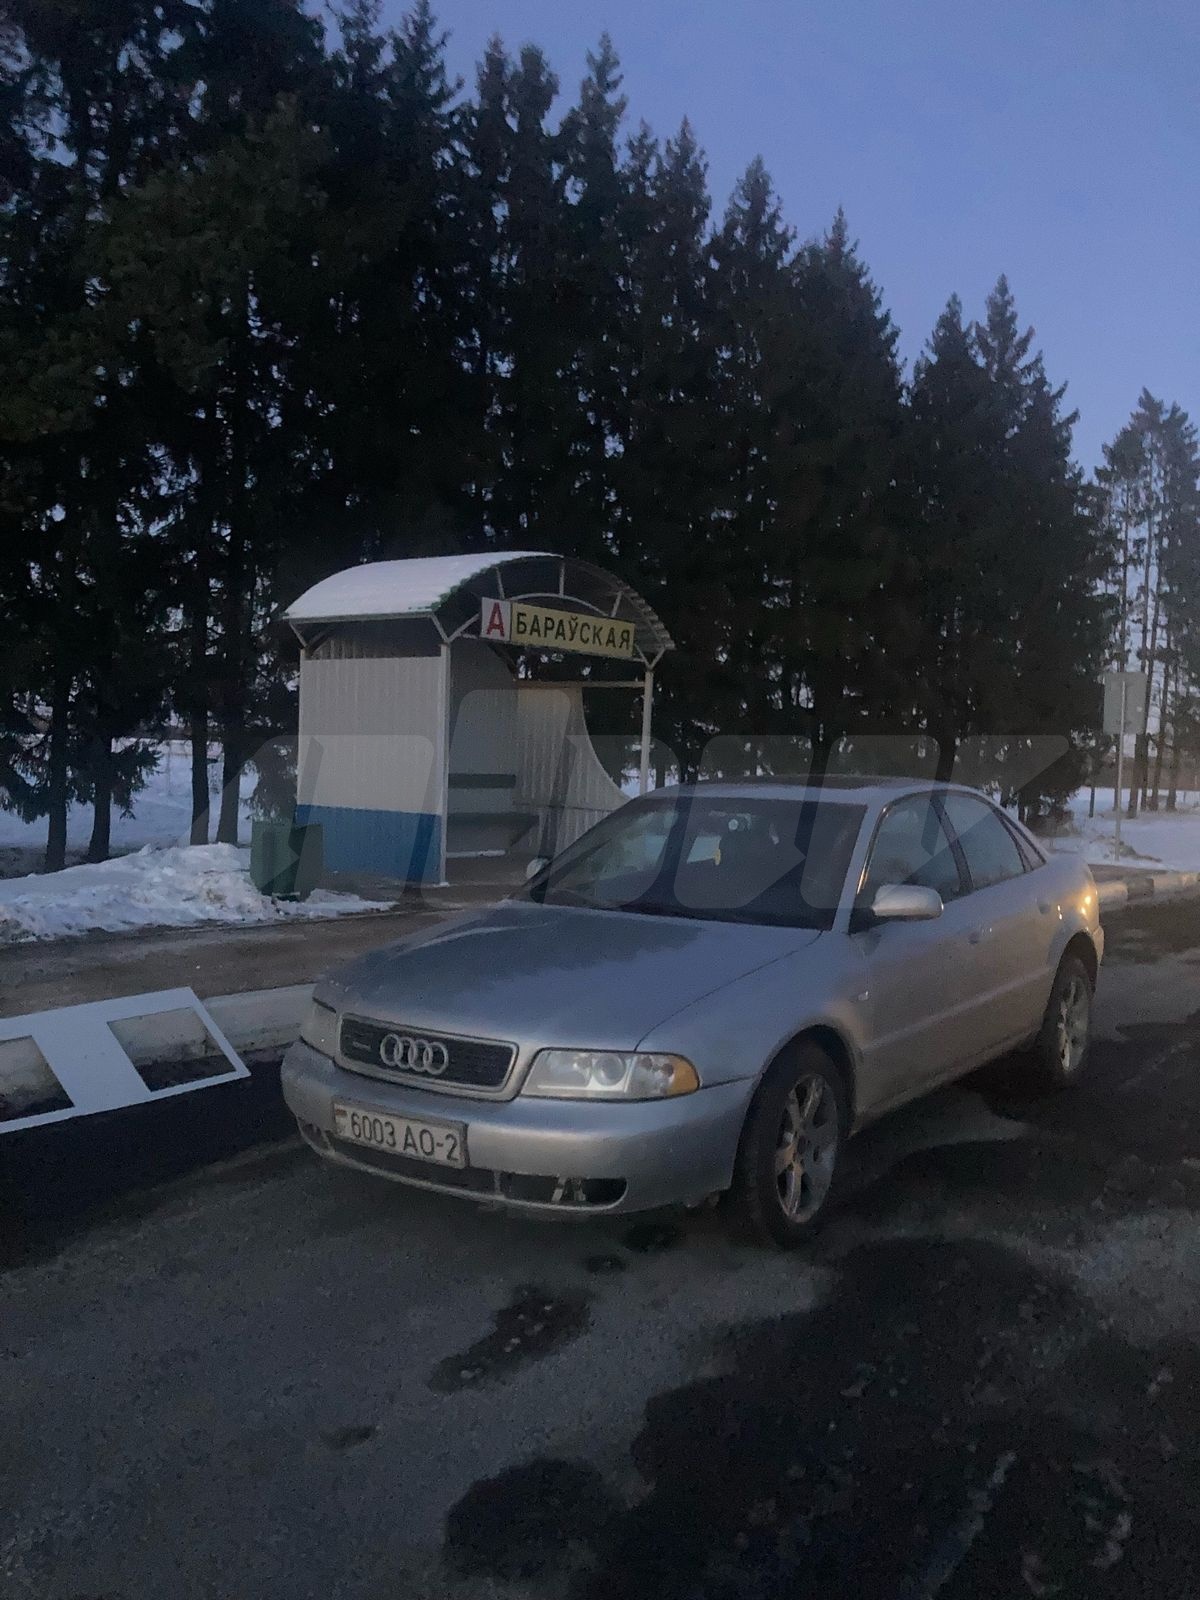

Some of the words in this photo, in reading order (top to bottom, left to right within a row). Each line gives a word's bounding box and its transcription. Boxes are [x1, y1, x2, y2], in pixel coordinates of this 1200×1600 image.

[485, 602, 505, 638] А
[515, 612, 631, 651] БАРАЎСКАЯ
[350, 1111, 397, 1148] 6003
[402, 1124, 459, 1162] AO-2
